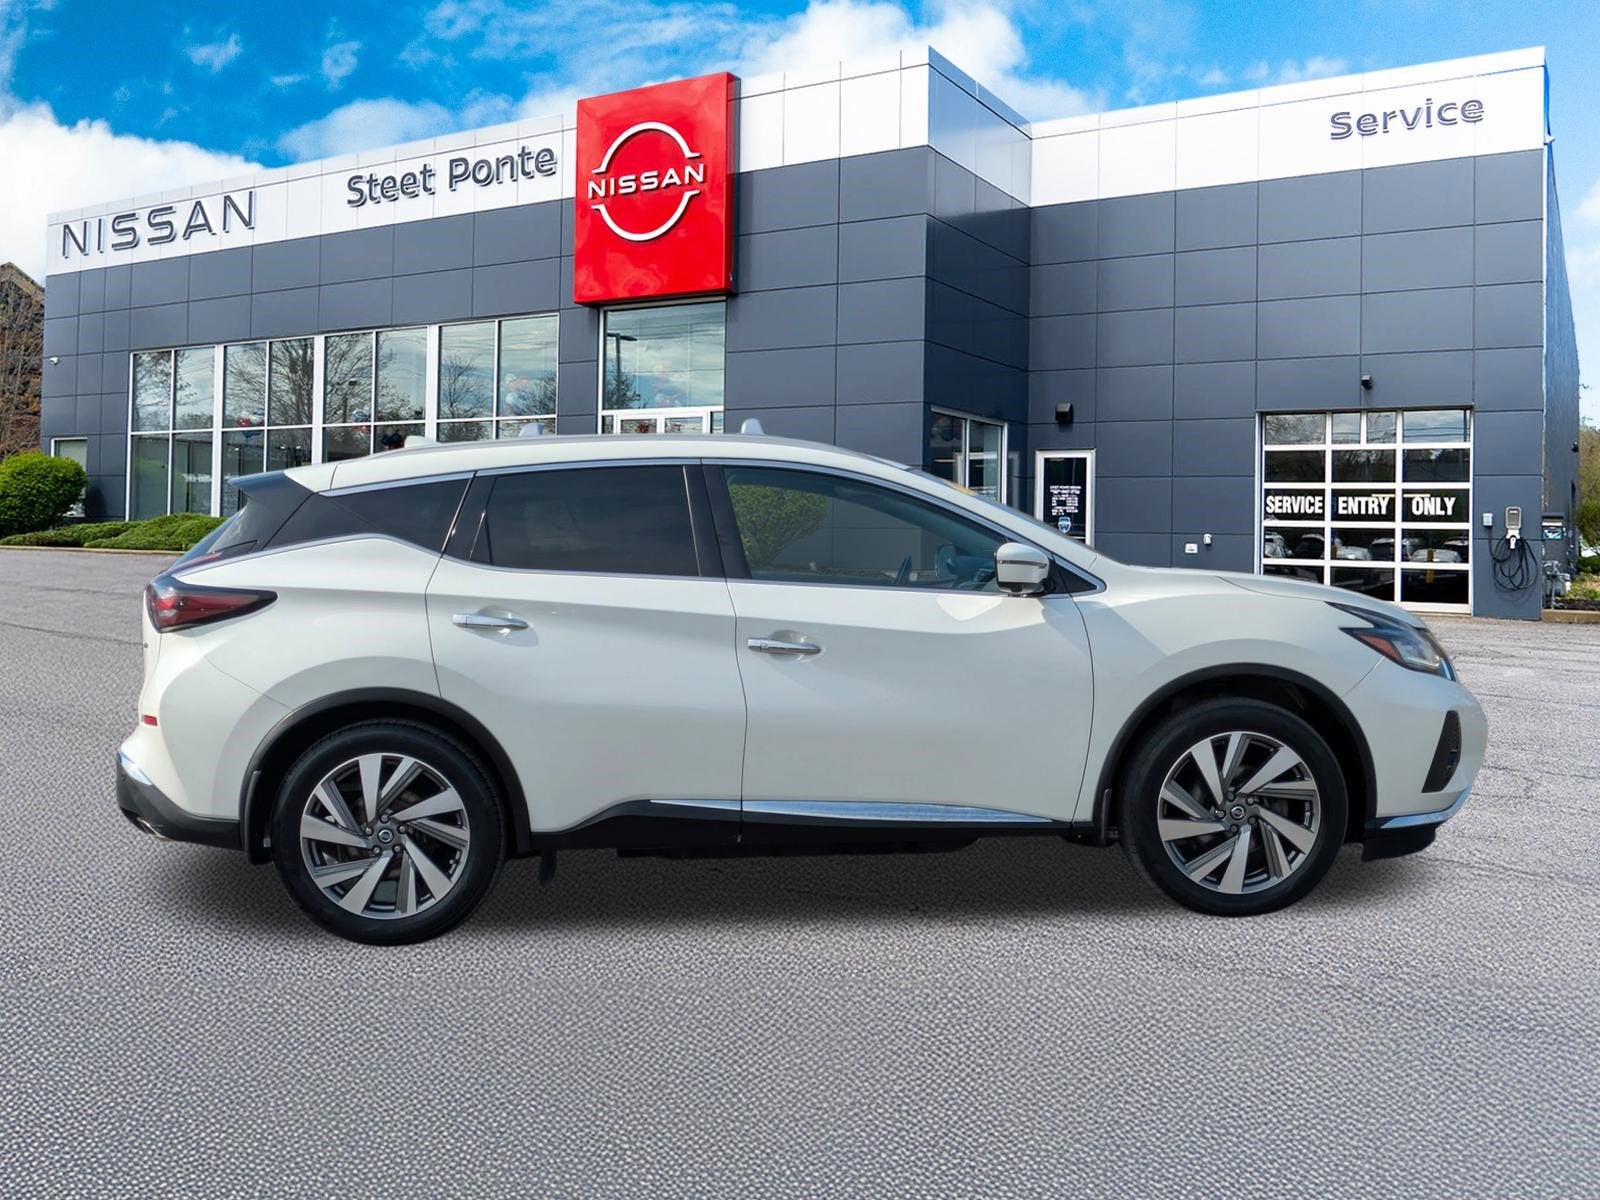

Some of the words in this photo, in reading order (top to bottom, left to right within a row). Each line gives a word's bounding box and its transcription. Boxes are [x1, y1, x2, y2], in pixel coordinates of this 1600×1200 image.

[1330, 98, 1484, 140] Service
[347, 163, 435, 207] Steet
[449, 146, 557, 191] Ponte
[588, 163, 705, 199] NISSAN
[62, 191, 255, 259] NISSAN
[1266, 495, 1323, 514] SERVICE
[1338, 496, 1389, 515] ENTRY
[1411, 497, 1456, 516] ONLY
